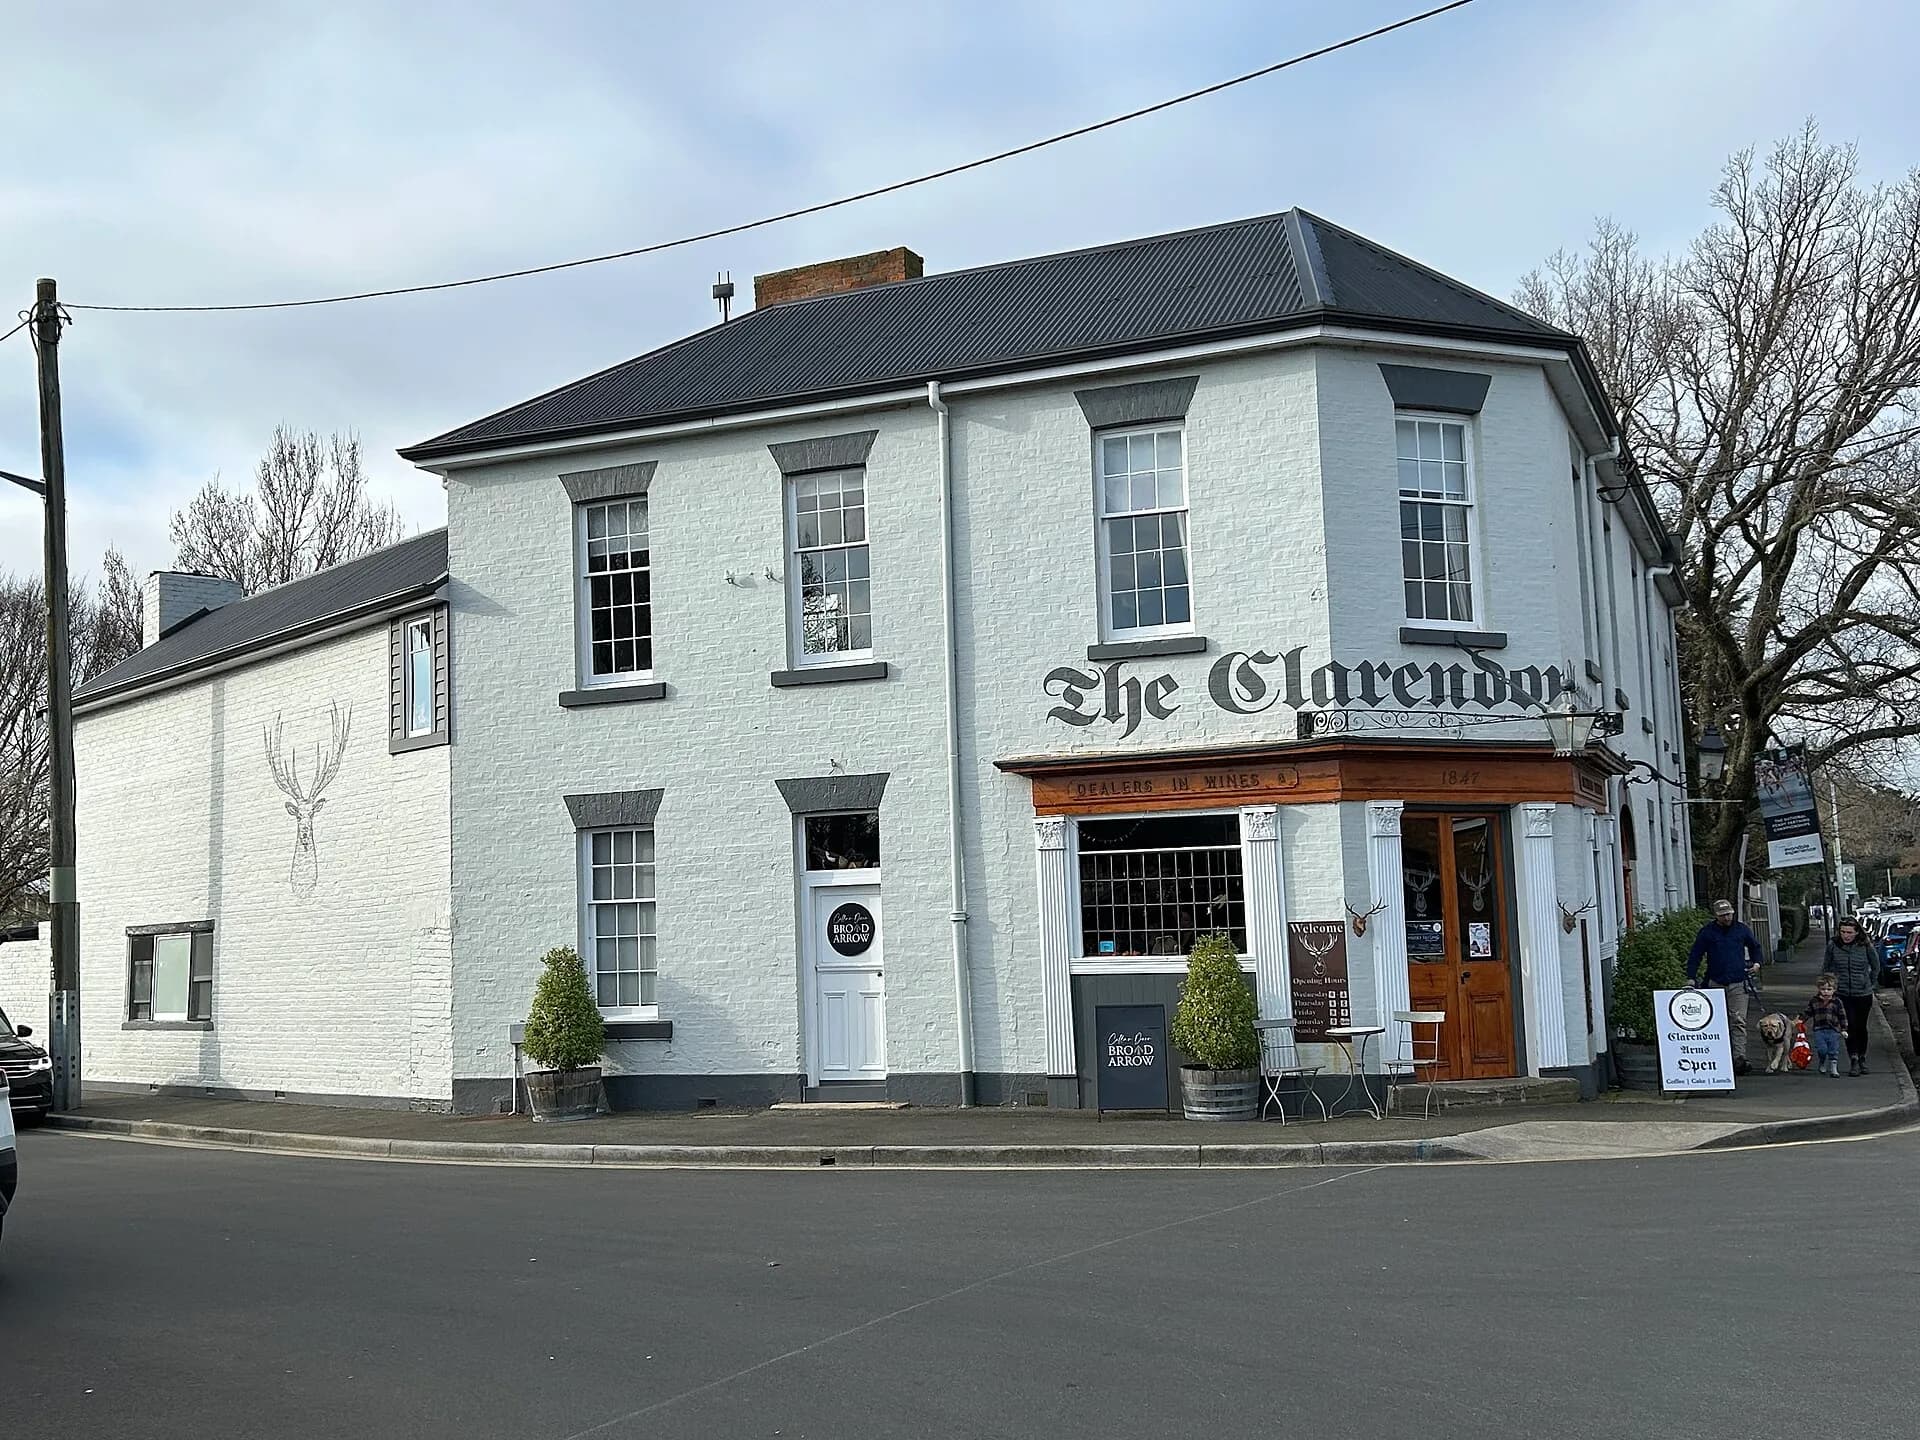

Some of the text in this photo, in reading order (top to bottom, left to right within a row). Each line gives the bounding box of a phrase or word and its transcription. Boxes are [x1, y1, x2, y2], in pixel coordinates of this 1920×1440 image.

[1043, 661, 1181, 740] The
[1441, 770, 1480, 785] 1847
[1077, 780, 1153, 797] DEALERS
[1171, 777, 1190, 792] IN
[1204, 775, 1260, 789] WINES
[1290, 923, 1344, 934] Welcome
[833, 933, 870, 943] ARROW
[1292, 977, 1323, 985] Opening
[1293, 991, 1328, 999] Wednesday
[1294, 1000, 1325, 1008] Thursday
[1294, 1008, 1316, 1016] Friday
[1667, 1032, 1721, 1041] Clarendon
[1680, 1045, 1710, 1054] Arms
[1108, 1055, 1155, 1067] ARROW
[1678, 1059, 1717, 1074] Open
